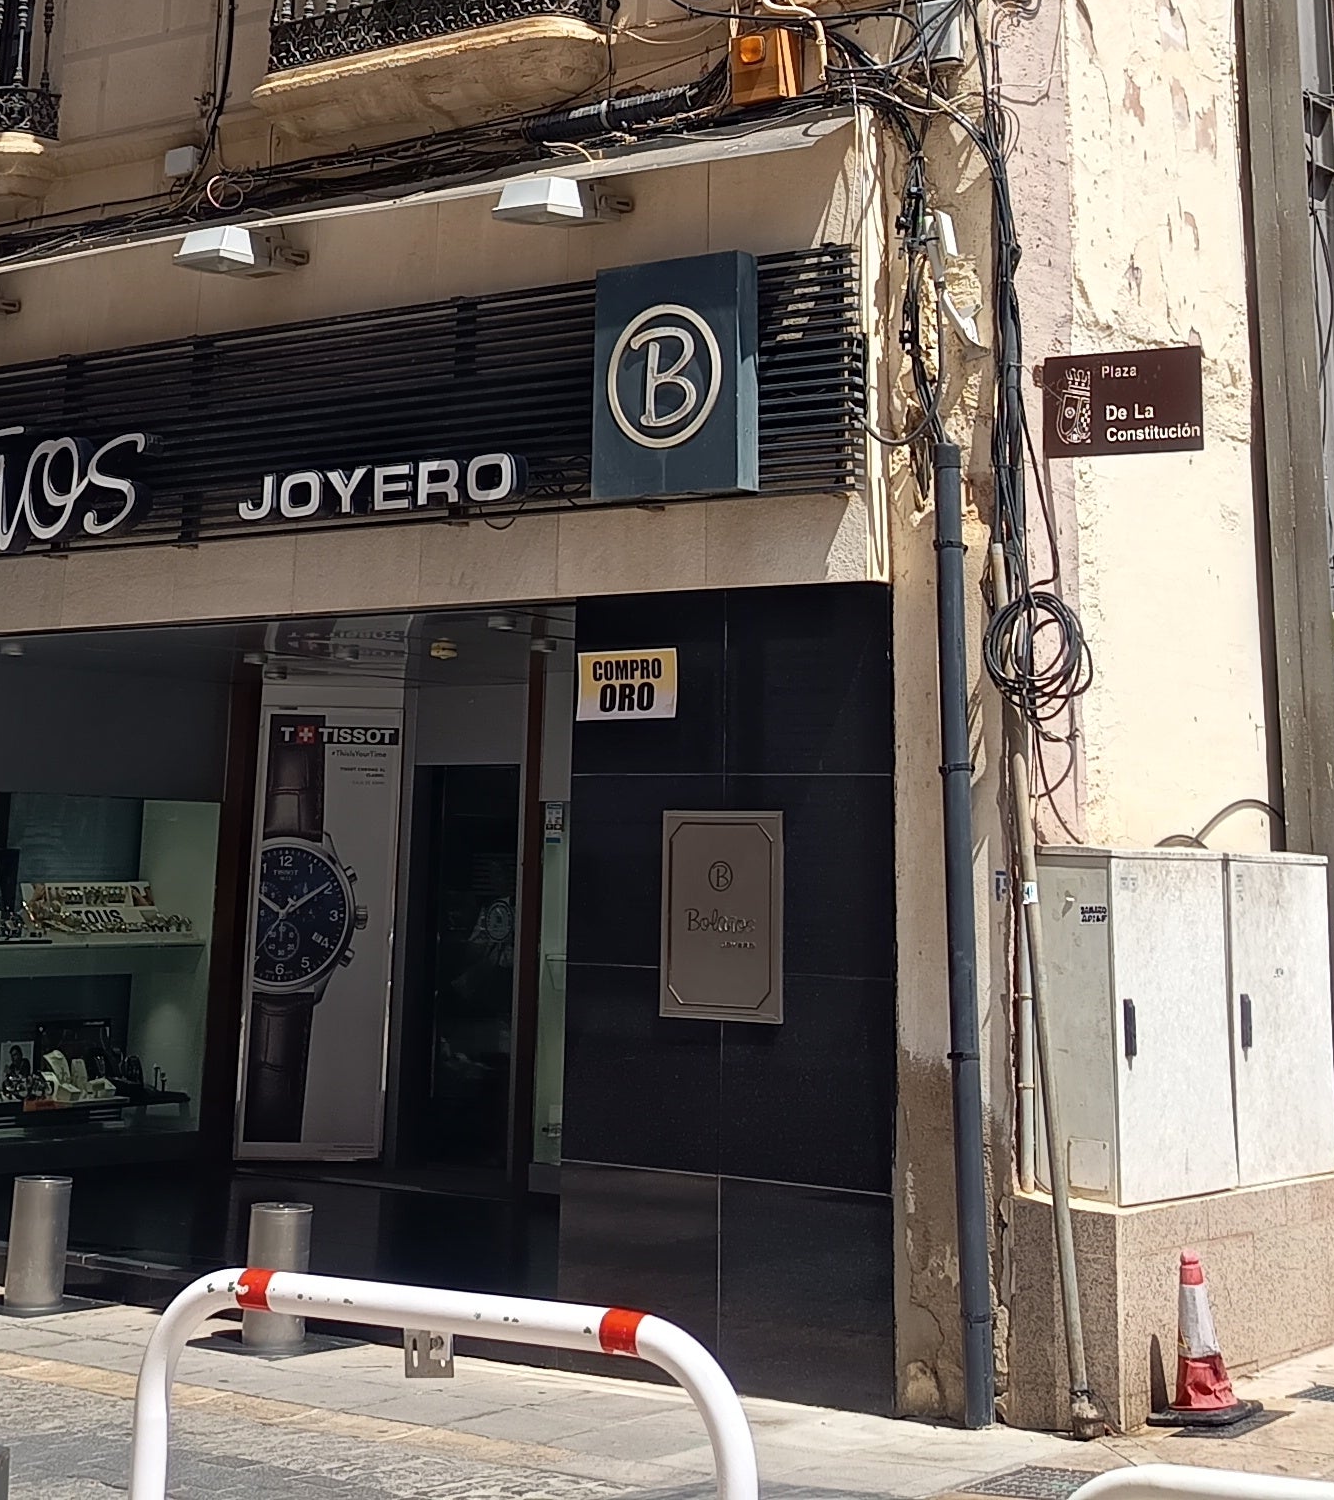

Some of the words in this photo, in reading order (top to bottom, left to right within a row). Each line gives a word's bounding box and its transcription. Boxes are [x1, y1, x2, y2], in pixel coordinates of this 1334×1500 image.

[1101, 366, 1137, 379] Plaza
[1105, 405, 1128, 421] De
[1134, 404, 1154, 419] La
[1106, 422, 1201, 442] Constitución
[237, 451, 520, 522] JOYERO
[592, 657, 662, 682] COMPRO
[599, 681, 655, 713] ORO
[318, 727, 395, 744] TISSOT
[279, 855, 293, 867] 12
[323, 883, 333, 895] 2
[329, 910, 339, 921] 3
[320, 938, 329, 949] 4
[275, 963, 285, 975] 6
[300, 956, 310, 969] 5
